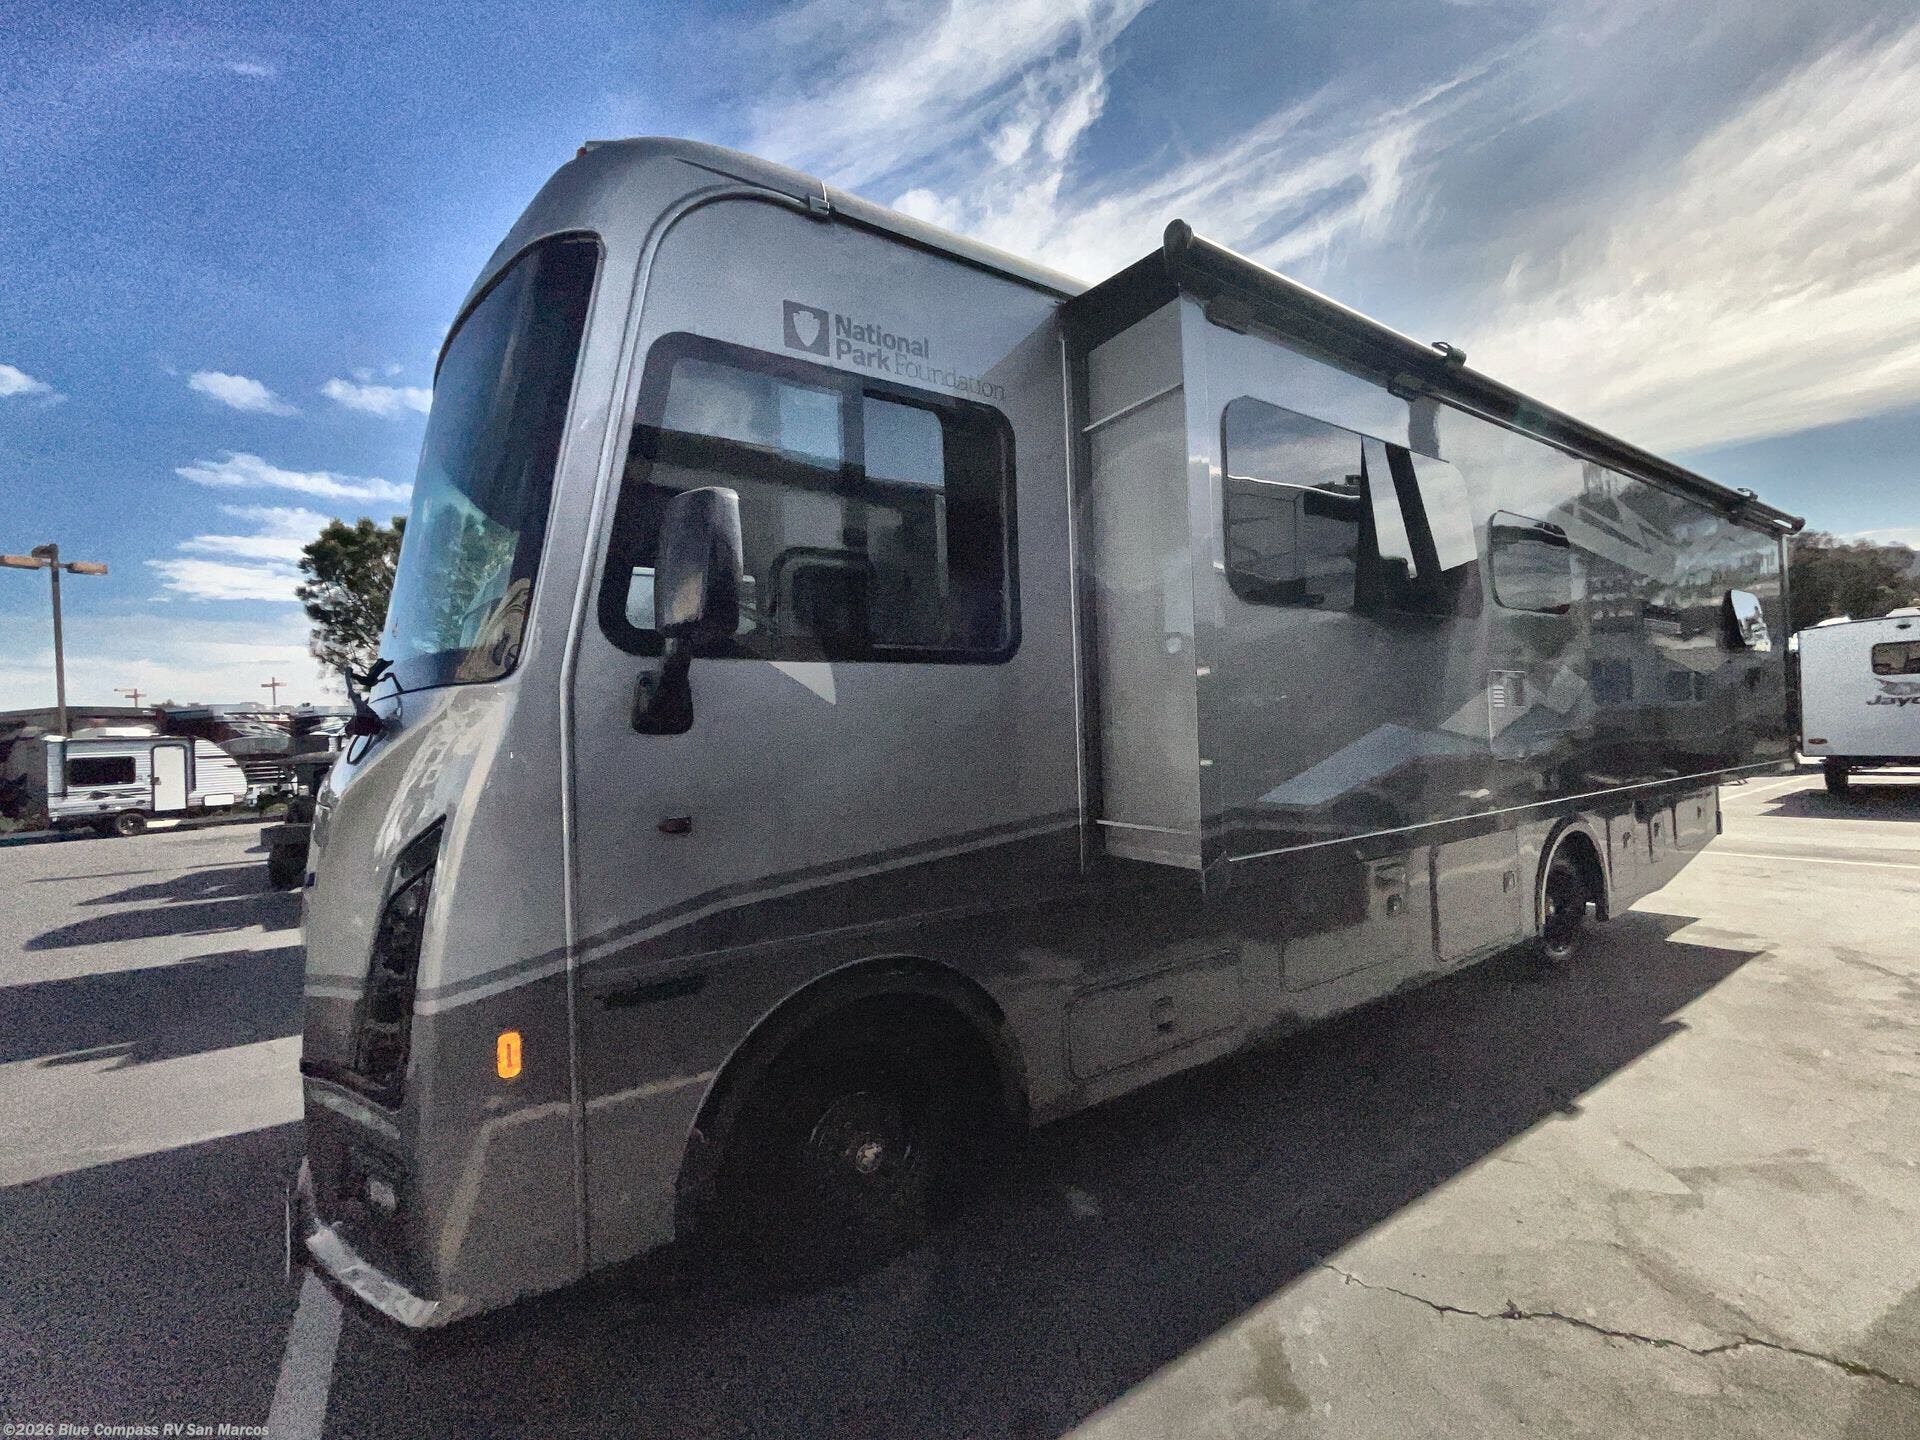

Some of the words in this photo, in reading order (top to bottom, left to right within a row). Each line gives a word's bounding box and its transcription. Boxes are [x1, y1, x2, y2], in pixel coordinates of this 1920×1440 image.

[835, 314, 929, 359] National
[836, 338, 891, 372] Park
[895, 352, 1005, 400] Foundation
